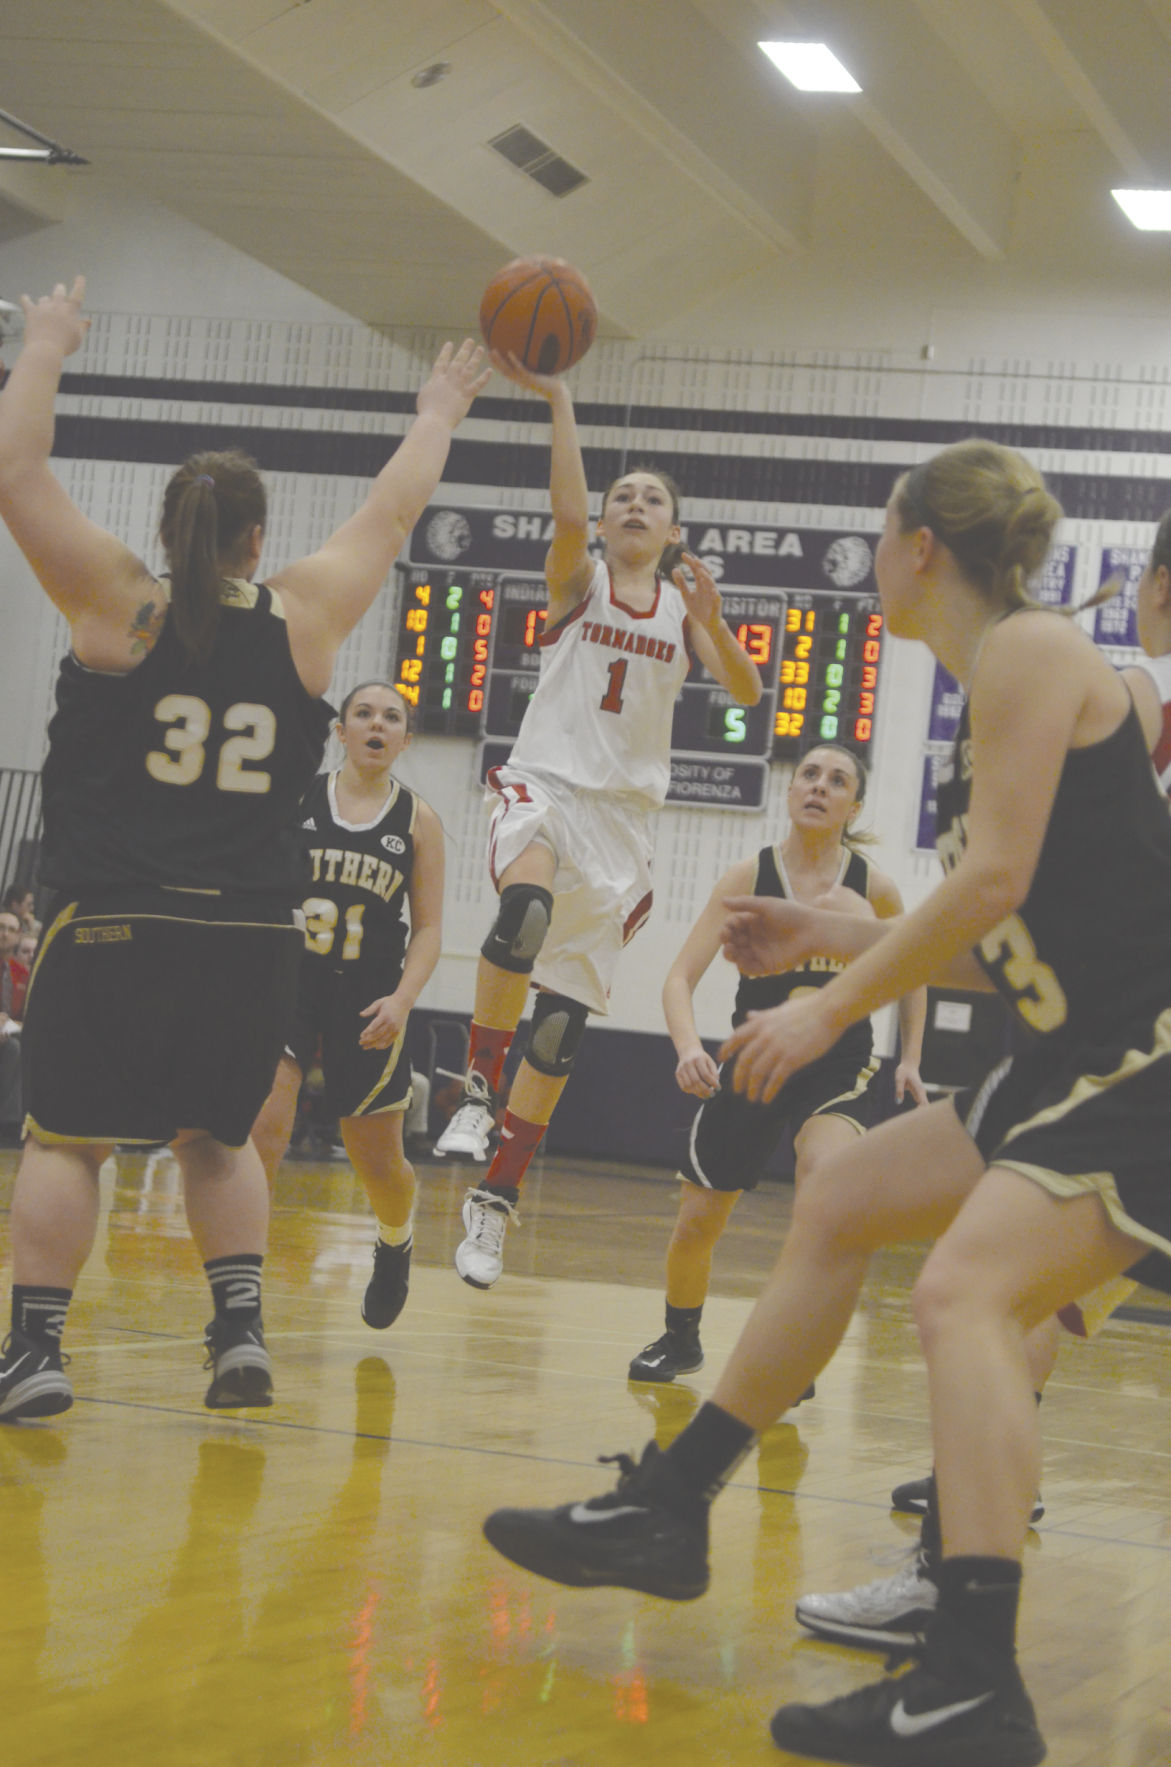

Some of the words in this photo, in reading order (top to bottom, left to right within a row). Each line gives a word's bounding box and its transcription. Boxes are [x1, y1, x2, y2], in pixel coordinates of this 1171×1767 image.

[699, 528, 803, 558] AREA
[415, 584, 431, 607] 4
[446, 586, 463, 610] 2
[479, 589, 494, 611] 4
[722, 595, 780, 617] ISITOR
[405, 608, 428, 632] 10
[450, 612, 460, 634] 1
[476, 614, 492, 637] 0
[785, 608, 816, 632] 31
[838, 612, 849, 634] 1
[866, 614, 883, 637] 2
[416, 635, 426, 657] 1
[440, 636, 458, 660] 0
[473, 639, 488, 662] 5
[795, 635, 813, 660] 2
[835, 638, 847, 661] 1
[863, 640, 880, 663] 0
[401, 659, 423, 682] 12
[445, 662, 455, 684] 1
[470, 664, 486, 687] 2
[600, 657, 629, 716] 1
[780, 660, 810, 685] 33
[825, 663, 844, 688] 0
[861, 666, 878, 690] 3
[442, 687, 452, 710] 1
[467, 689, 484, 713] 0
[782, 686, 807, 711] 10
[822, 689, 841, 714] 2
[859, 692, 875, 715] 3
[723, 707, 746, 743] 5
[774, 711, 804, 737] 32
[819, 715, 838, 739] 0
[854, 718, 872, 742] 0
[145, 693, 277, 794] 32
[670, 763, 710, 778] OSITY
[712, 765, 735, 780] OF
[386, 836, 404, 851] KC
[75, 924, 133, 944] SOUTHERN
[301, 897, 366, 961] 31
[981, 911, 1068, 1034] 3
[225, 1282, 259, 1309] 2
